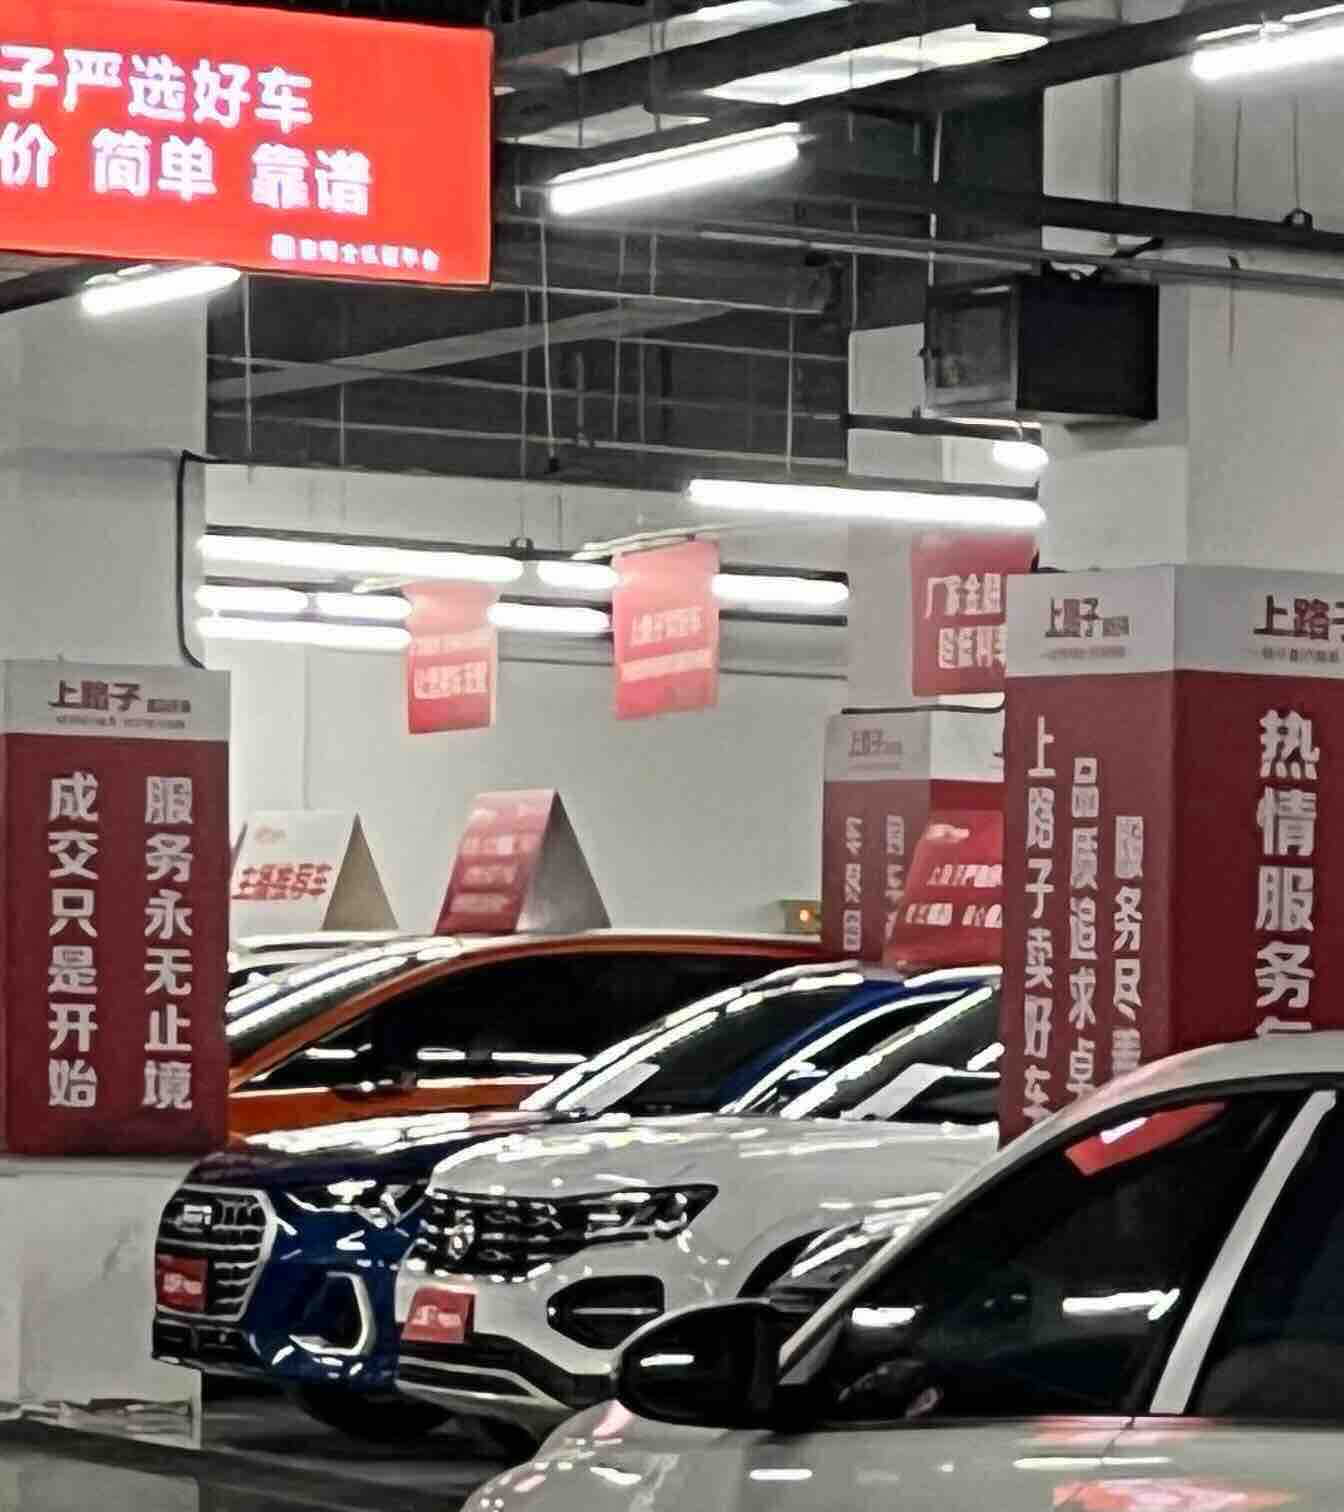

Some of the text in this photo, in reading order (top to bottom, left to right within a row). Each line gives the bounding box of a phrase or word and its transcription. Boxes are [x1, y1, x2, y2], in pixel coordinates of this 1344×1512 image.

[0, 46, 313, 133] 子严选好车
[91, 128, 218, 203] 简单
[250, 143, 373, 217] 靠谱
[48, 771, 99, 1108] 成交只是开始
[144, 775, 195, 1111] 服务永无止境
